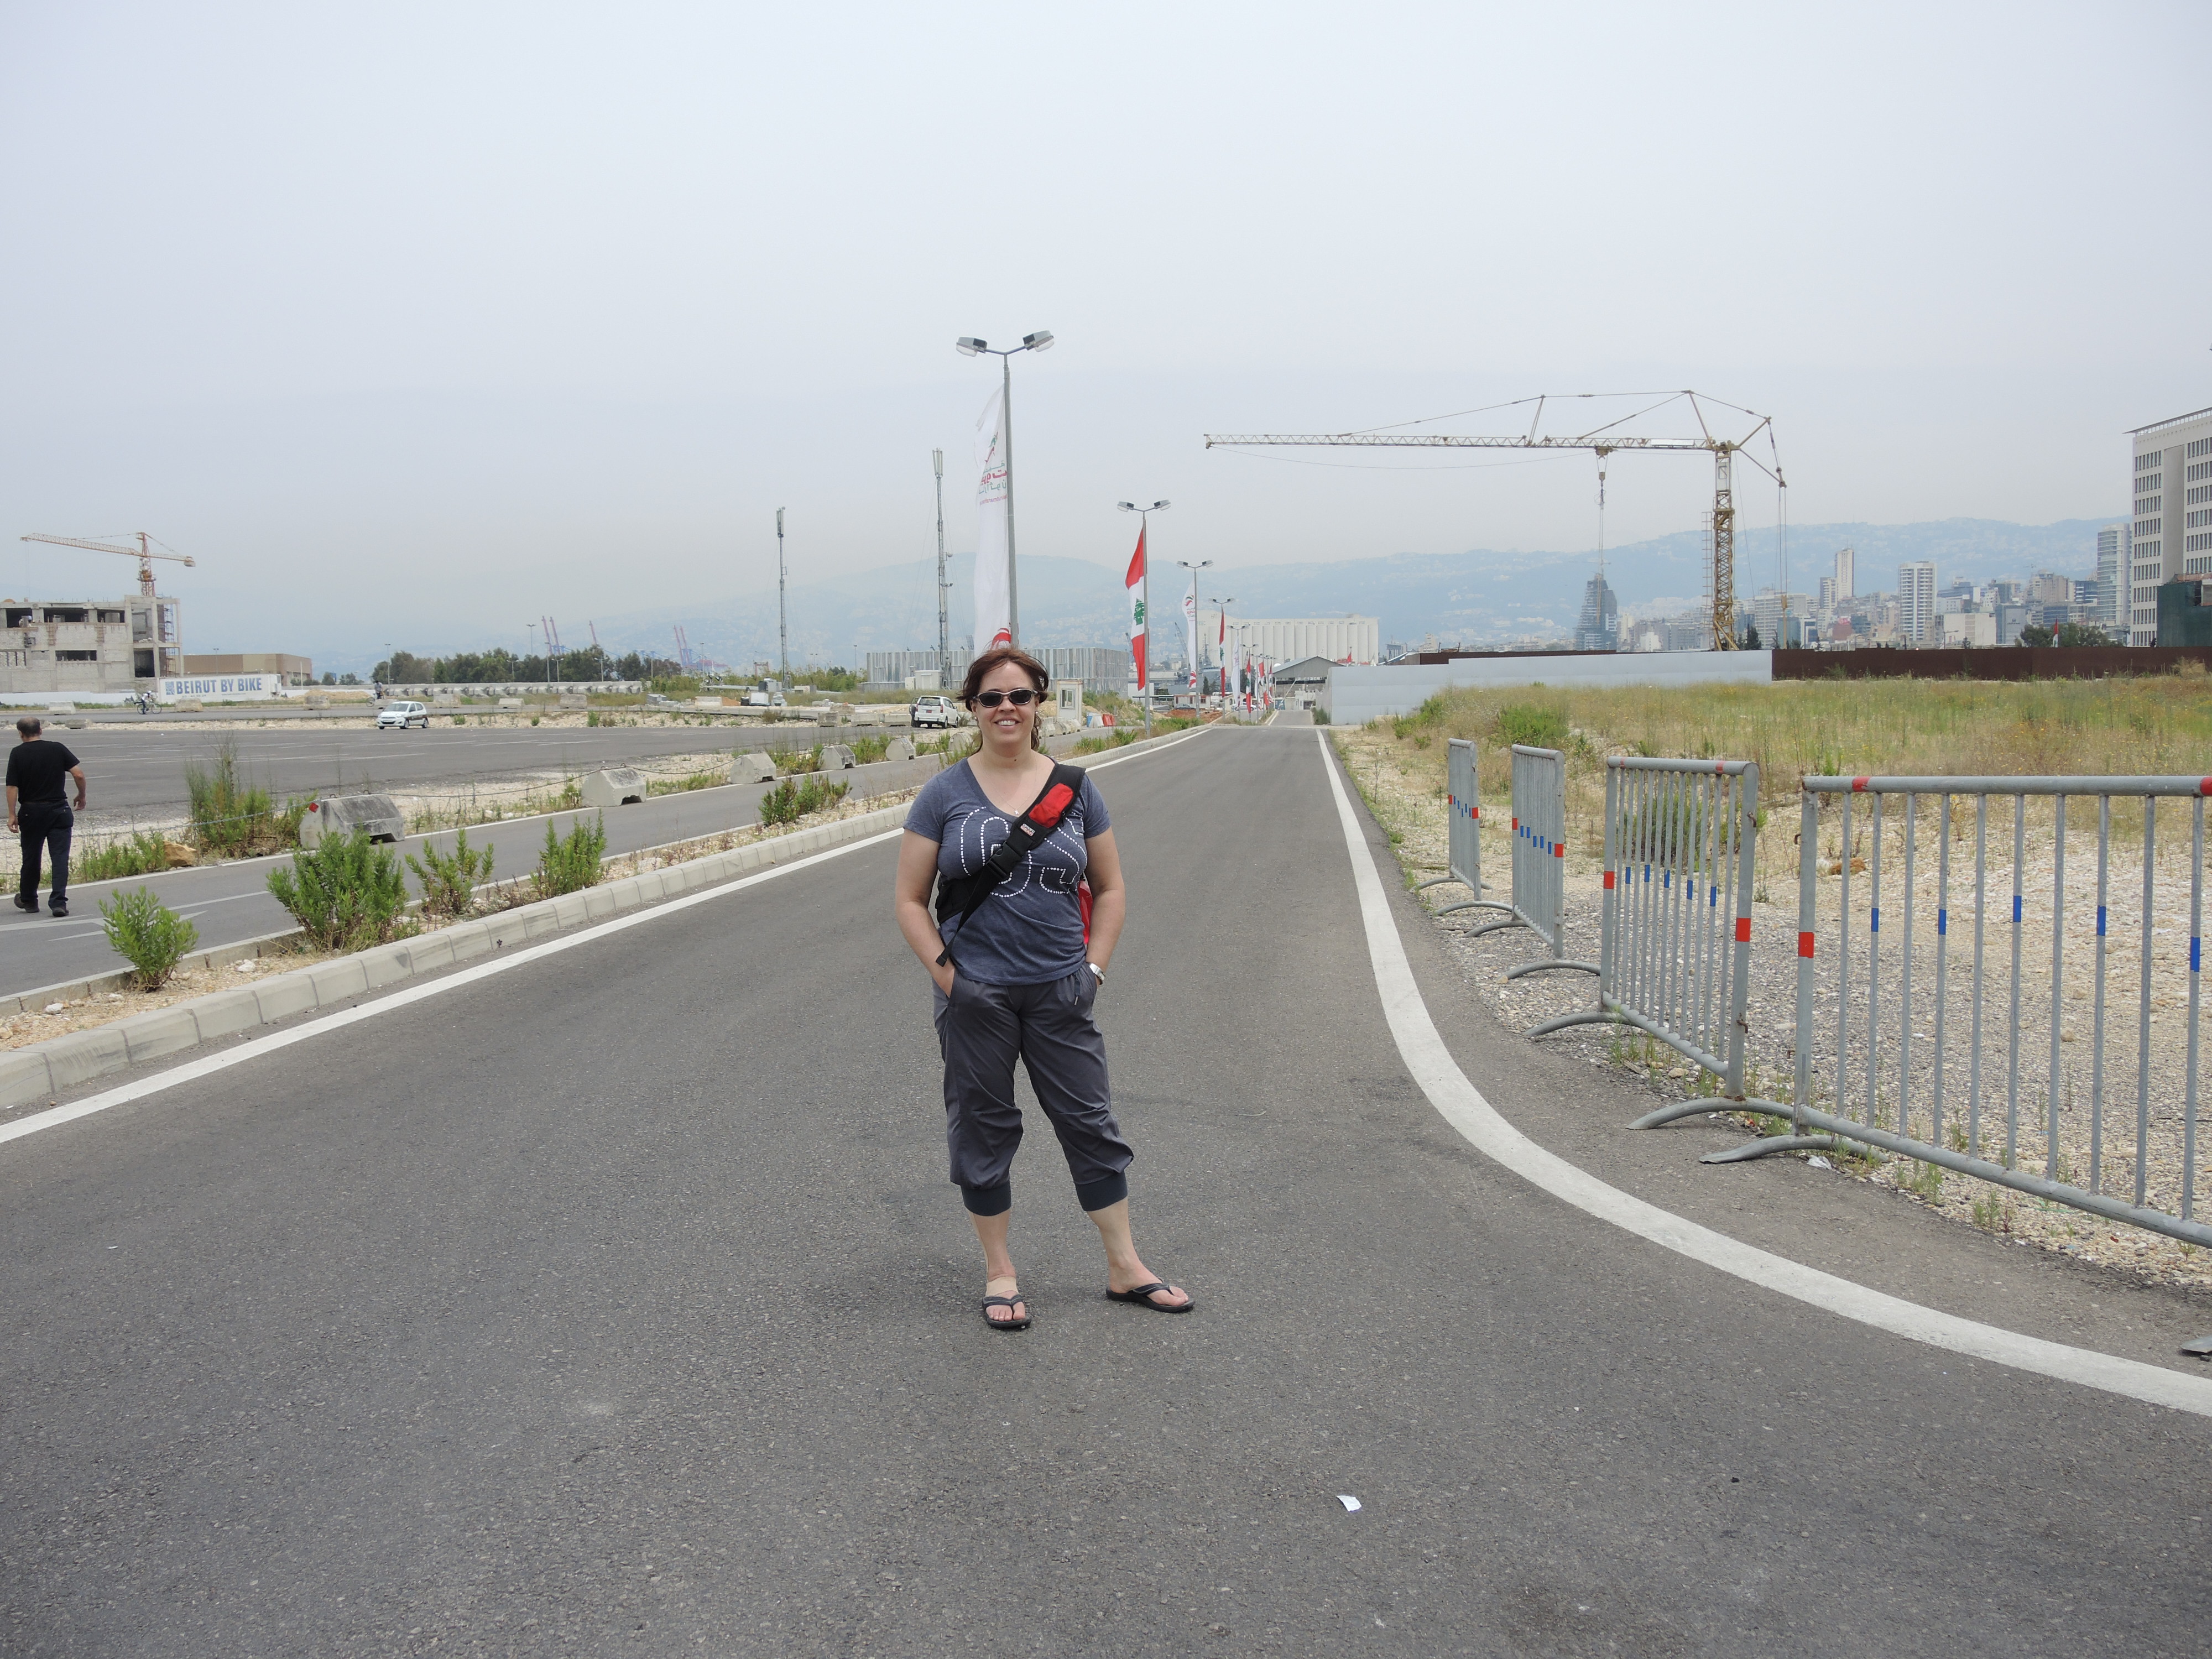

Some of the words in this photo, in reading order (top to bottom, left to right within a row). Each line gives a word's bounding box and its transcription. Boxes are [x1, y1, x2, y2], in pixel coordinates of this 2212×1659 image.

[176, 679, 217, 695] BEIRUT
[221, 679, 234, 692] BY
[238, 677, 262, 691] BIKE
